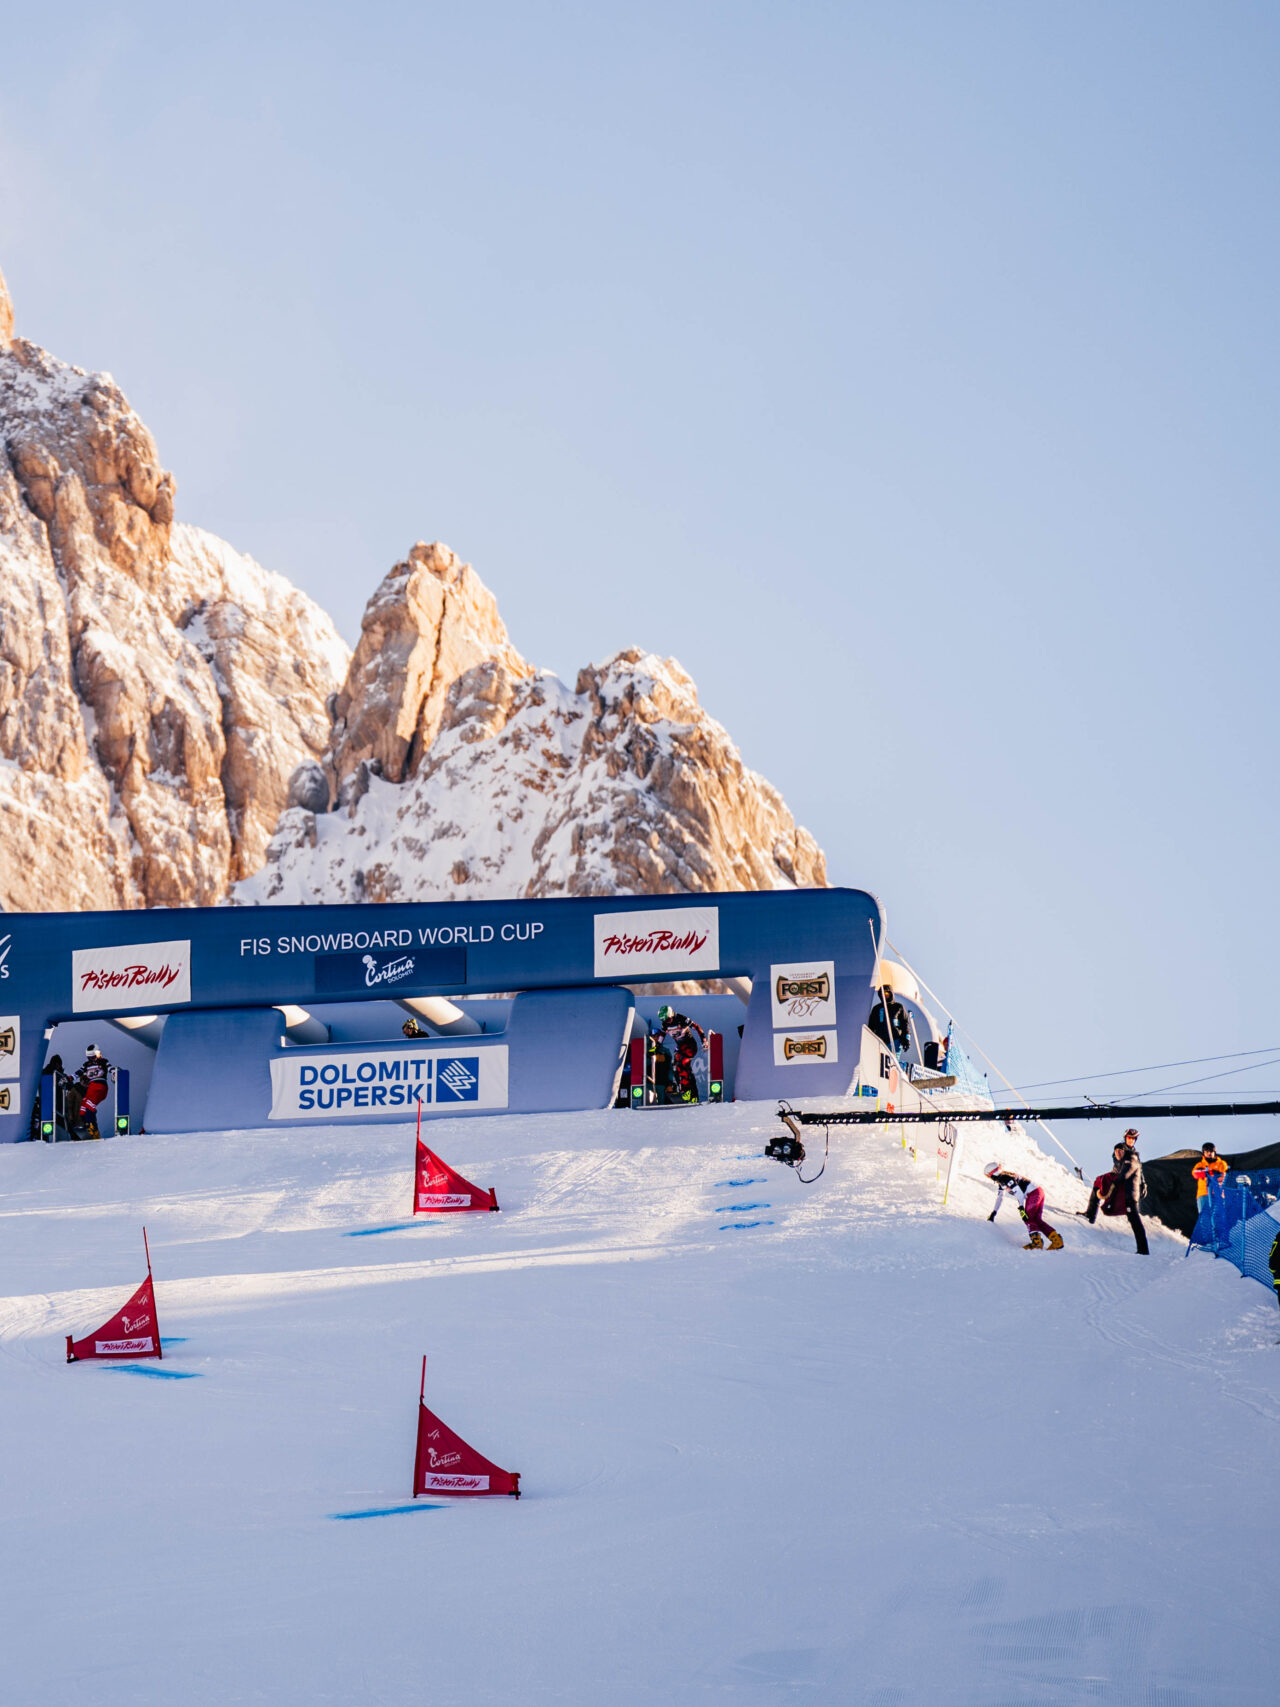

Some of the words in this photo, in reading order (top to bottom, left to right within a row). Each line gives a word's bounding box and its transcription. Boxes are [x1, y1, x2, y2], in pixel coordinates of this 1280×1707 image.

[240, 937, 271, 956] FIS
[277, 929, 412, 954] SNOWBOARD
[419, 925, 494, 945] WORLD
[501, 922, 545, 941] CUP
[603, 930, 707, 956] PistenBully
[81, 963, 180, 991] PistenBully
[363, 955, 415, 987] Cortina
[782, 981, 825, 996] FORST
[787, 997, 822, 1017] 1857
[788, 1042, 823, 1054] FORST
[300, 1059, 433, 1086] DOLOMITI
[298, 1083, 432, 1110] SUPERSKI
